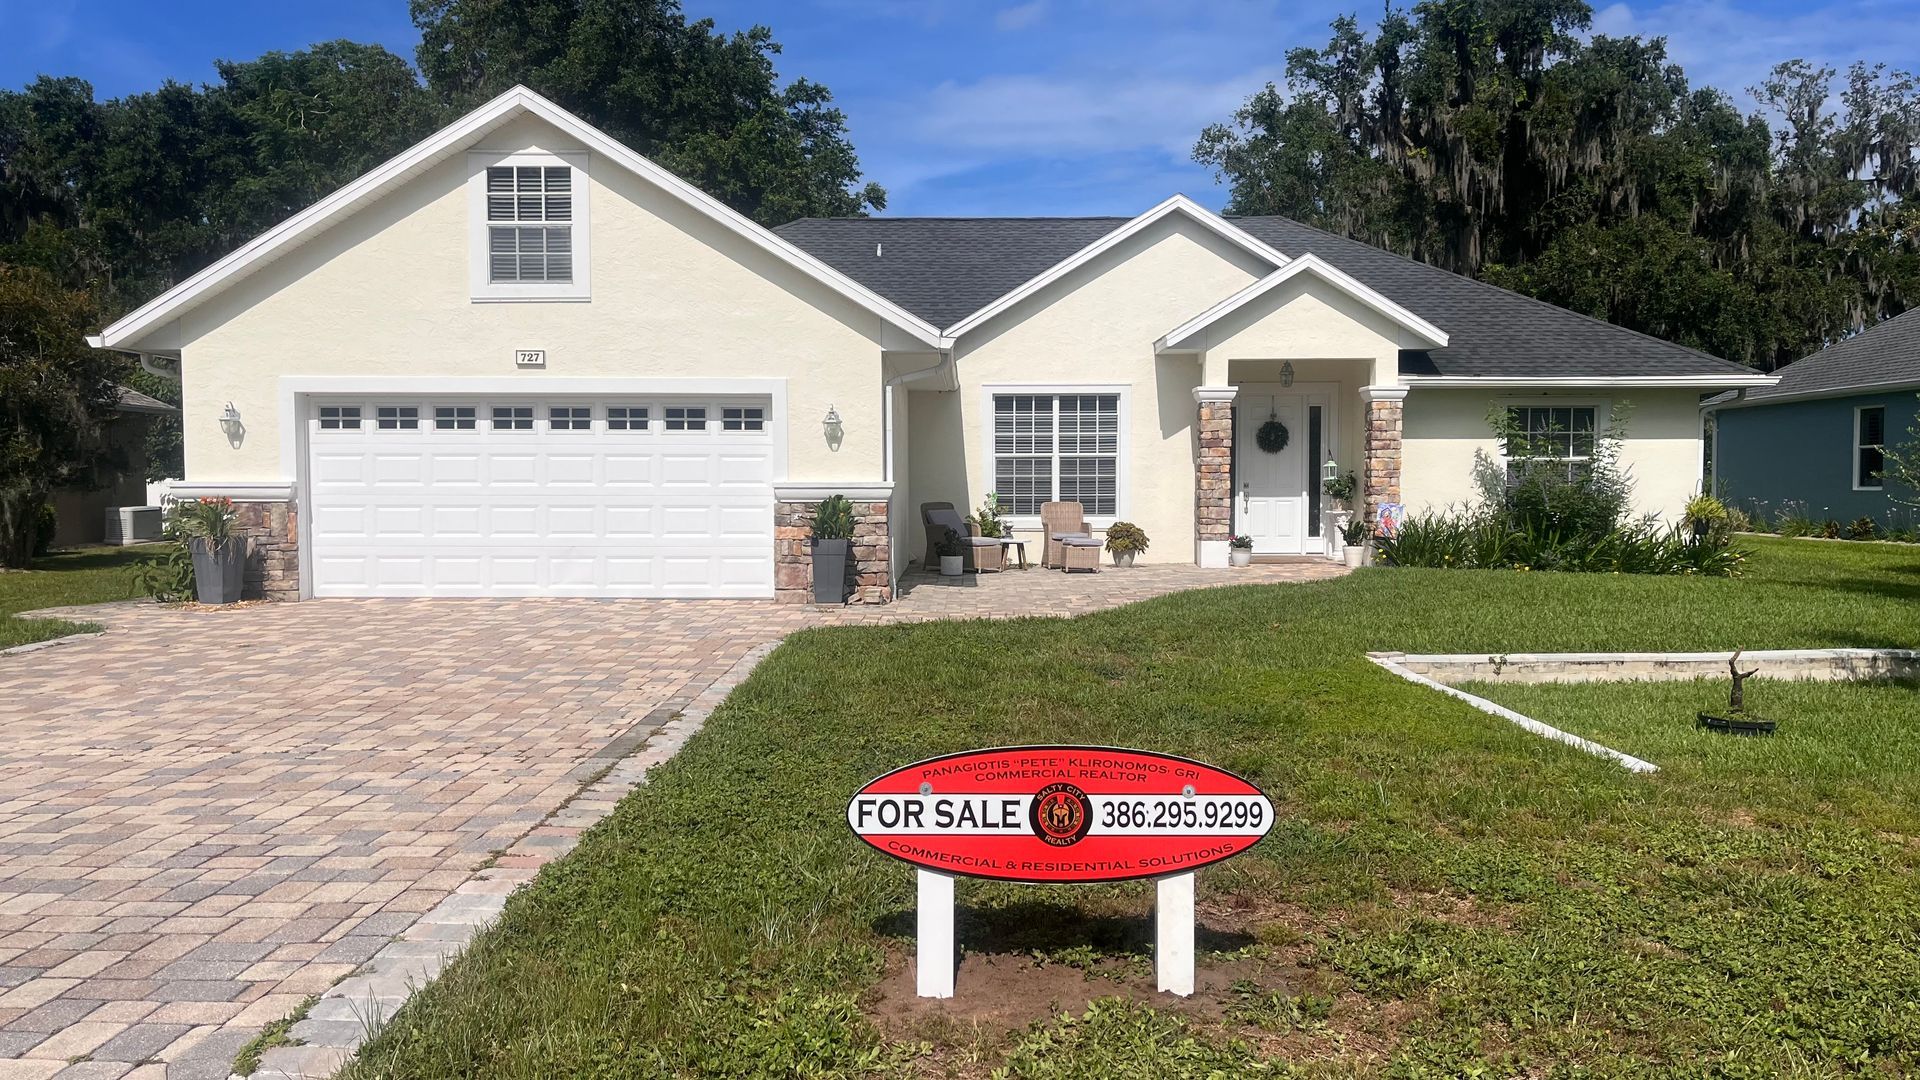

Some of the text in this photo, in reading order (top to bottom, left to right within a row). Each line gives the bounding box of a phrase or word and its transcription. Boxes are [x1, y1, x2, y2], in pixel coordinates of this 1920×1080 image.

[521, 353, 540, 362] 727
[922, 760, 1010, 779] PANAGIOTIS
[1175, 768, 1200, 780] GRI
[975, 769, 1147, 782] COMMERCIAL REALTOR
[1037, 784, 1086, 801] SALTY CITY
[857, 799, 1022, 828] FOR SALE
[1045, 835, 1077, 846] REALTY
[888, 841, 1234, 872] COMMERCIAL & RESIDENTIAL SOLUTIONS
